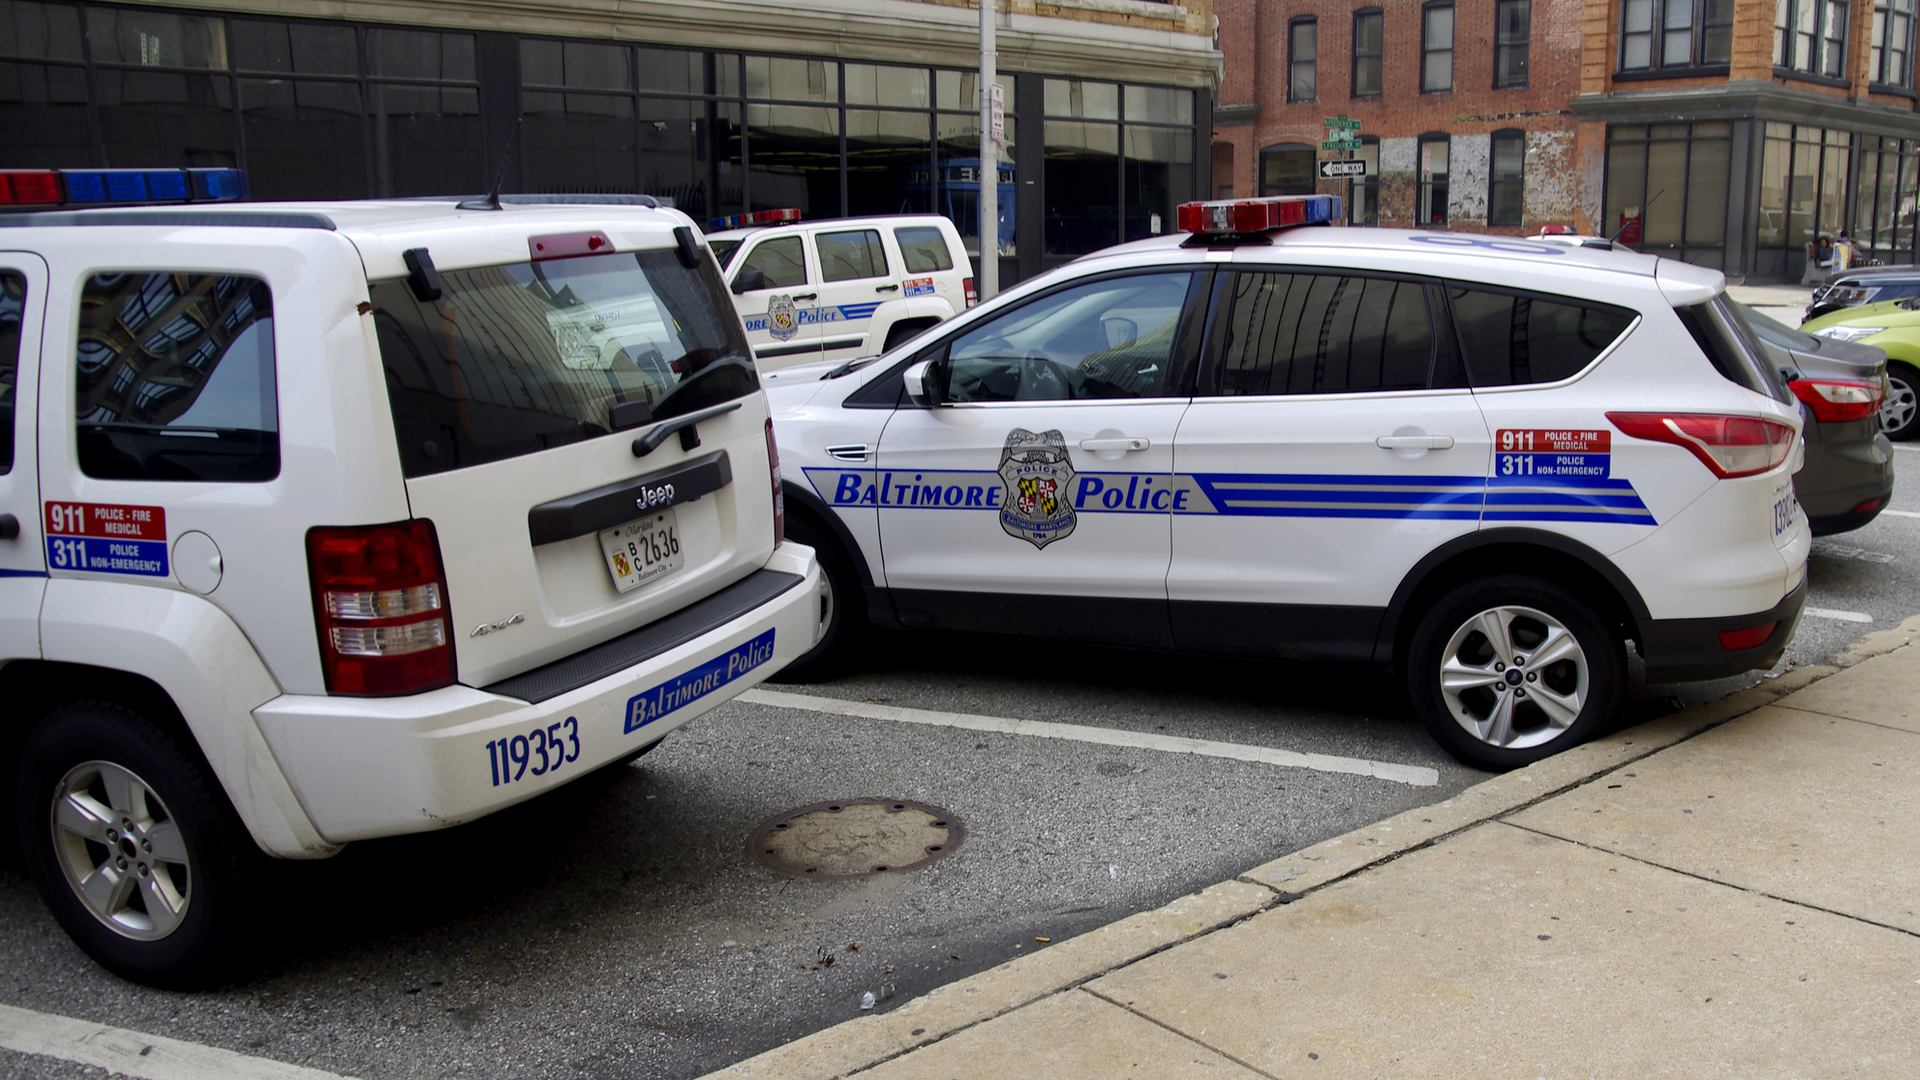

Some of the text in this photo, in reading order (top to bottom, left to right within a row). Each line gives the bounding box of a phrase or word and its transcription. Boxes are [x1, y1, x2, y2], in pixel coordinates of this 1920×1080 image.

[1502, 431, 1534, 450] 911
[1545, 431, 1572, 440] POLICE
[1581, 432, 1597, 441] FIRE
[1554, 441, 1588, 450] MEDICAL
[1502, 455, 1534, 476] 311
[1557, 456, 1584, 465] POLICE
[1017, 465, 1057, 475] POLICE
[1537, 466, 1603, 475] NON-EMERGENCY
[636, 483, 675, 510] Jeep
[51, 504, 84, 533] 911
[95, 508, 124, 520] POLICE
[133, 510, 151, 522] FIRE
[105, 522, 142, 535] MEDICAL
[54, 539, 87, 567] 311
[110, 544, 139, 556] POLICE
[641, 527, 679, 566] 2636
[91, 557, 161, 572] NON-EMERGENCY
[470, 611, 526, 638] 4x4
[486, 716, 580, 787] 119353
